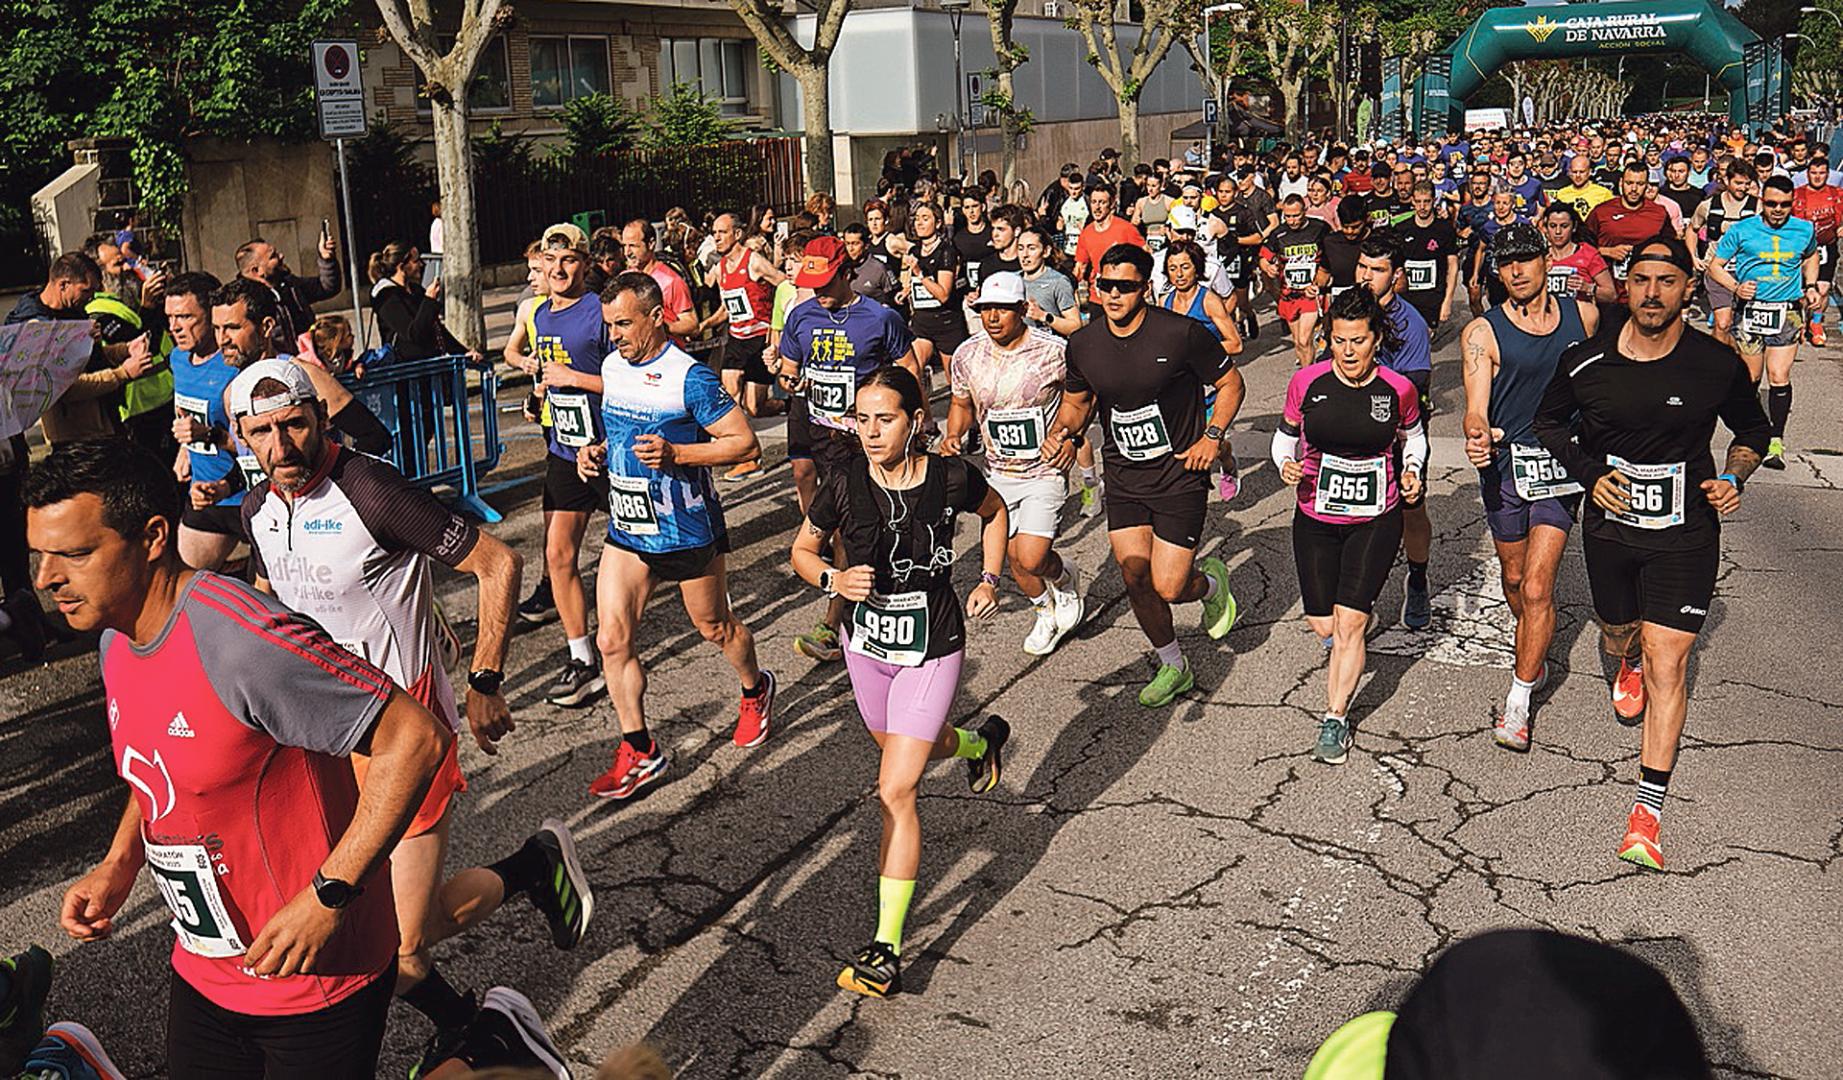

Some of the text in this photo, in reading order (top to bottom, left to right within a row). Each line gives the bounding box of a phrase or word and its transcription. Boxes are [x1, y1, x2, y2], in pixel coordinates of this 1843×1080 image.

[1566, 13, 1660, 29] CAJA RURAL
[1565, 27, 1667, 42] DE NAVARRA
[1598, 41, 1630, 49] ACCIÓN
[1207, 104, 1216, 119] P
[1752, 311, 1773, 326] 331
[997, 424, 1027, 445] 831
[1118, 422, 1159, 447] 1128
[1525, 458, 1567, 482] 956
[1328, 474, 1368, 501] 655
[304, 519, 342, 530] adi-ike
[865, 610, 915, 645] 930
